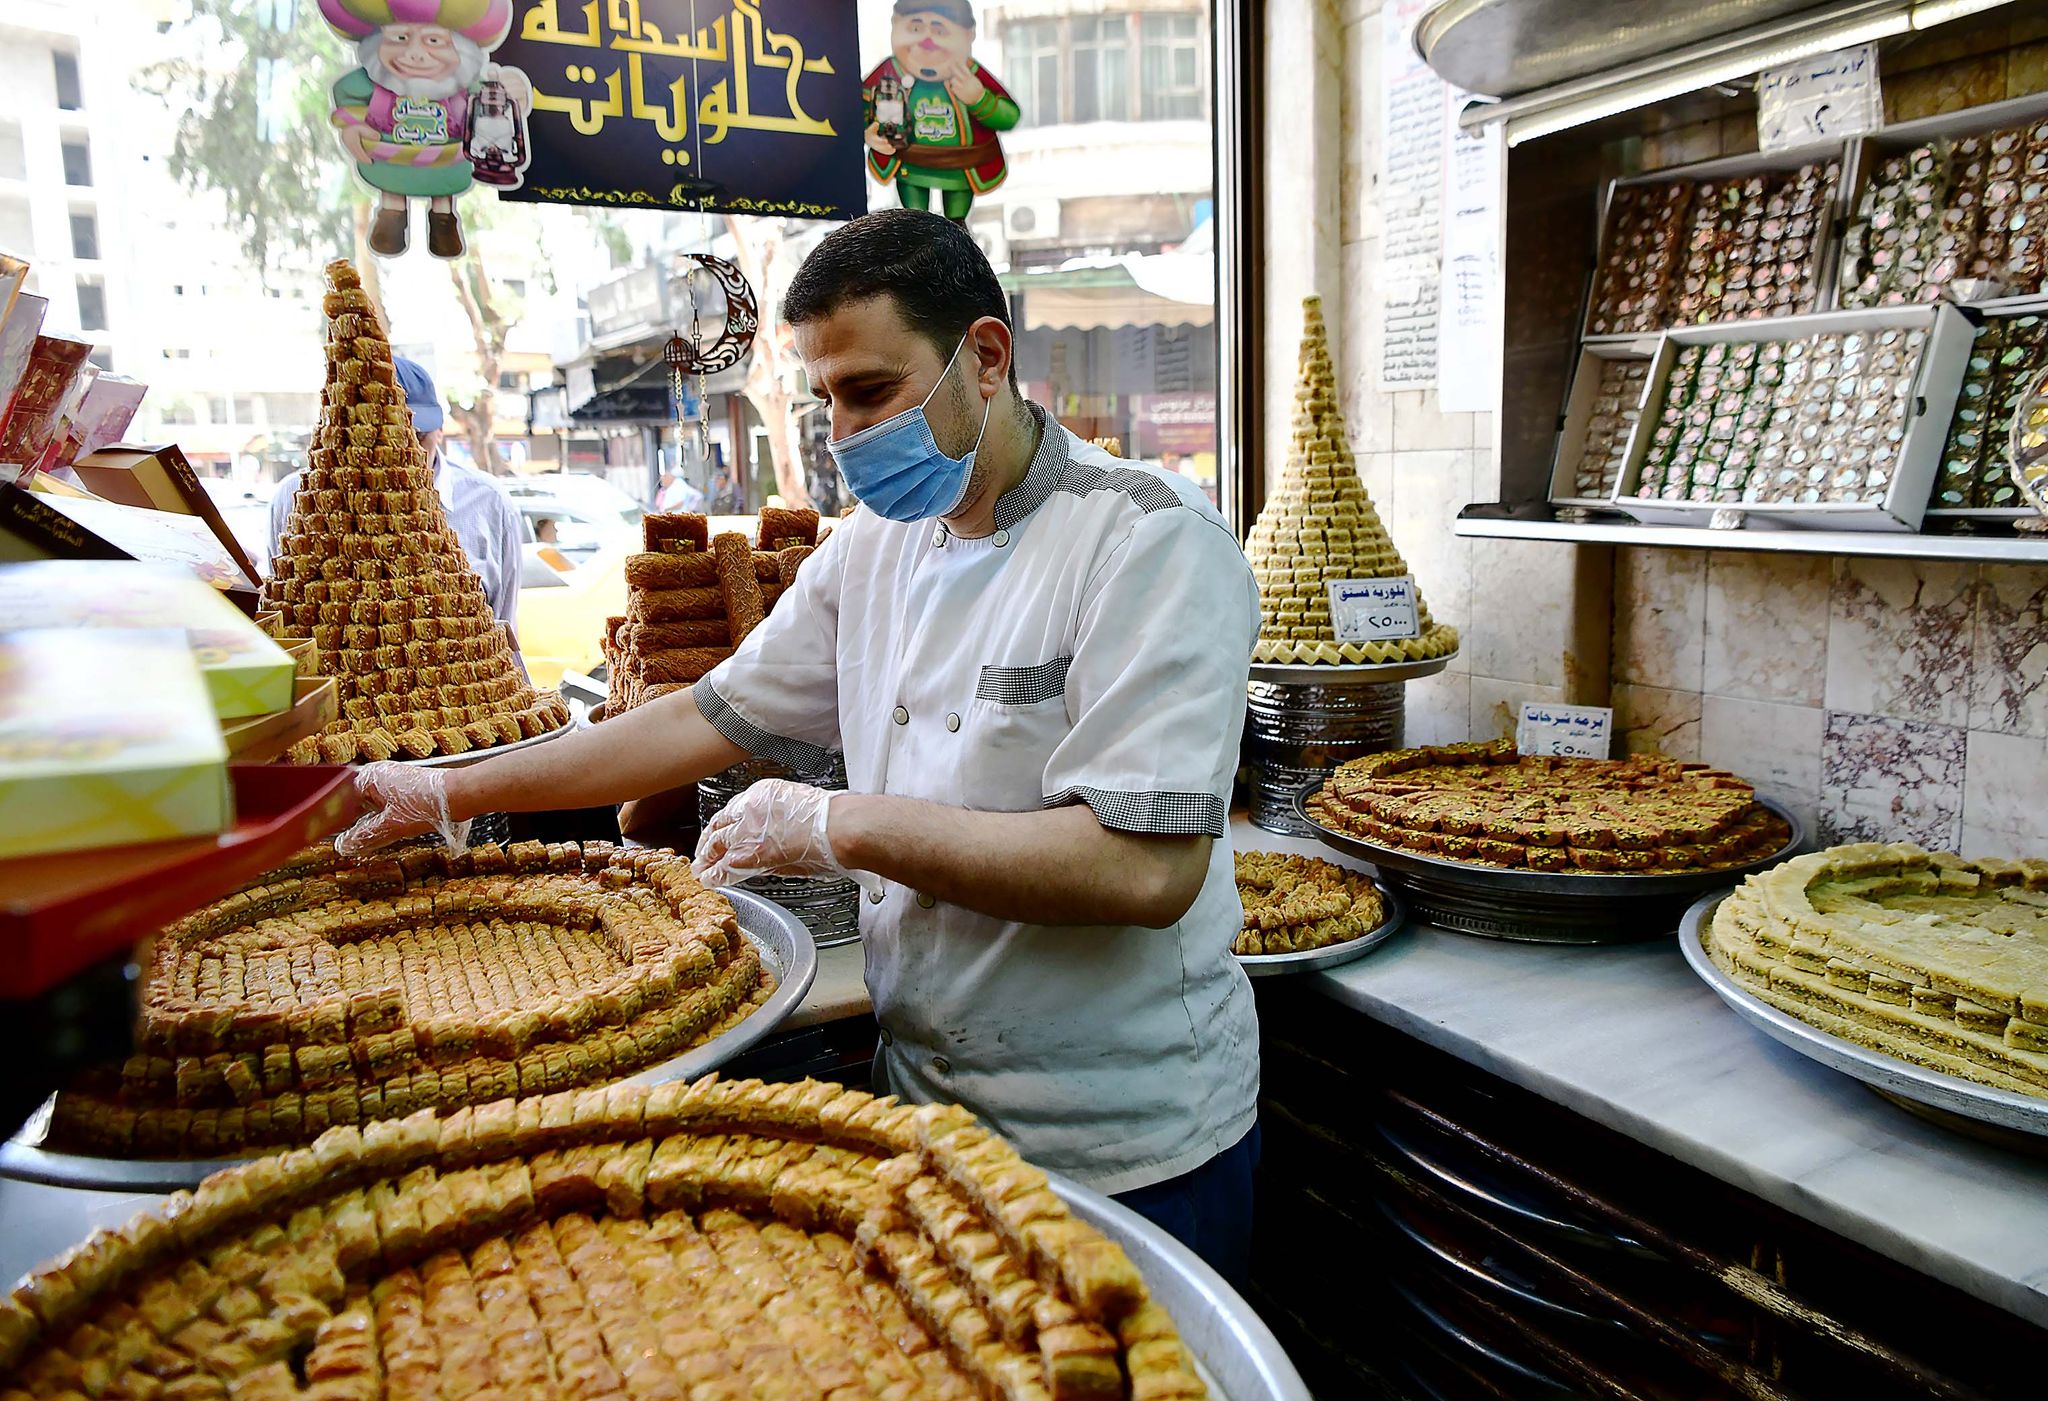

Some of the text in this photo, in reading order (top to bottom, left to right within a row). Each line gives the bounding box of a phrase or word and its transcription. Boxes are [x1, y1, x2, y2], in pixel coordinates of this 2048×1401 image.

[1340, 585, 1406, 602] بلورية فستق
[1368, 616, 1407, 628] ٢٥٠٠٠
